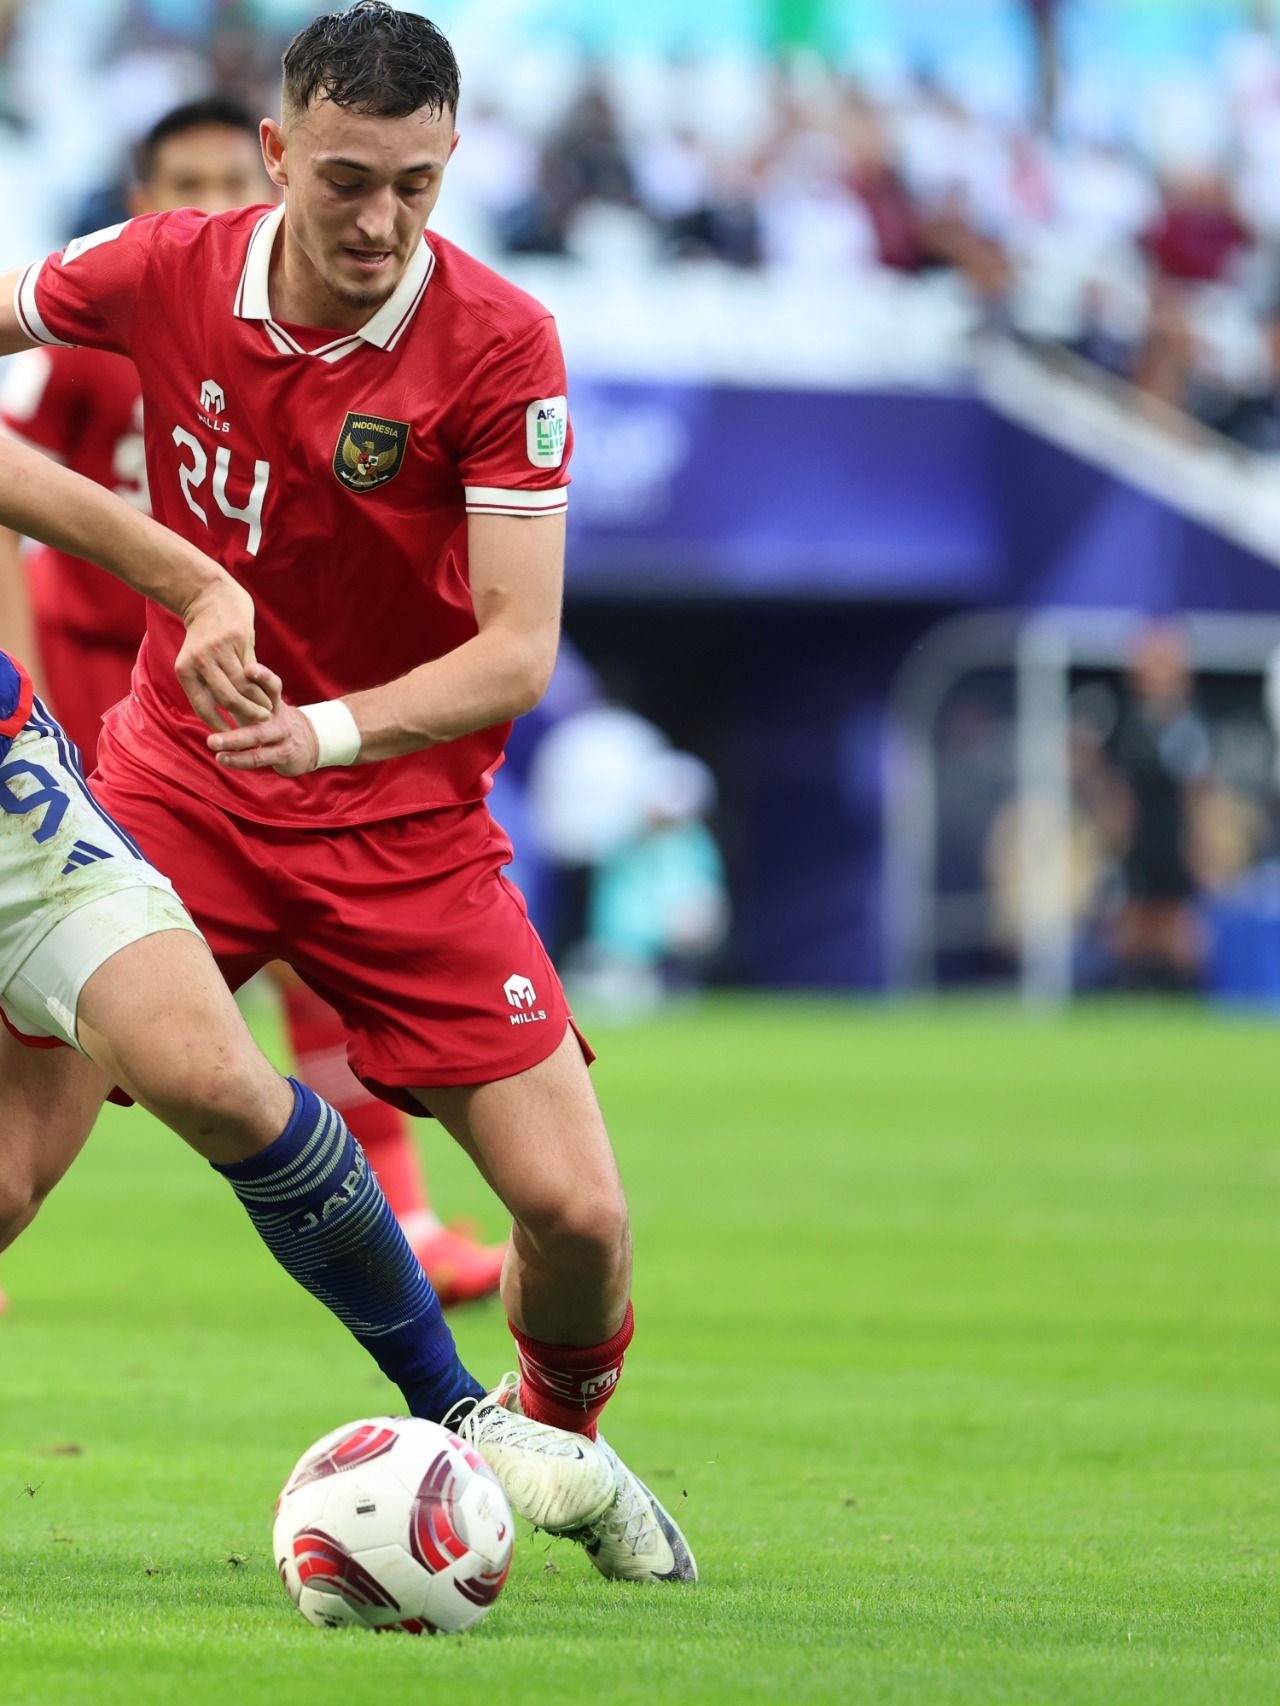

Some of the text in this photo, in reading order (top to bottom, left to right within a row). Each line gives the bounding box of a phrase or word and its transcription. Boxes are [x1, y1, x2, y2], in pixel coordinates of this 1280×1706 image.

[537, 408, 555, 420] AFC
[352, 421, 399, 438] INDONESIA
[537, 418, 563, 438] LIVE
[171, 425, 270, 557] 24
[510, 1010, 547, 1025] MILLS
